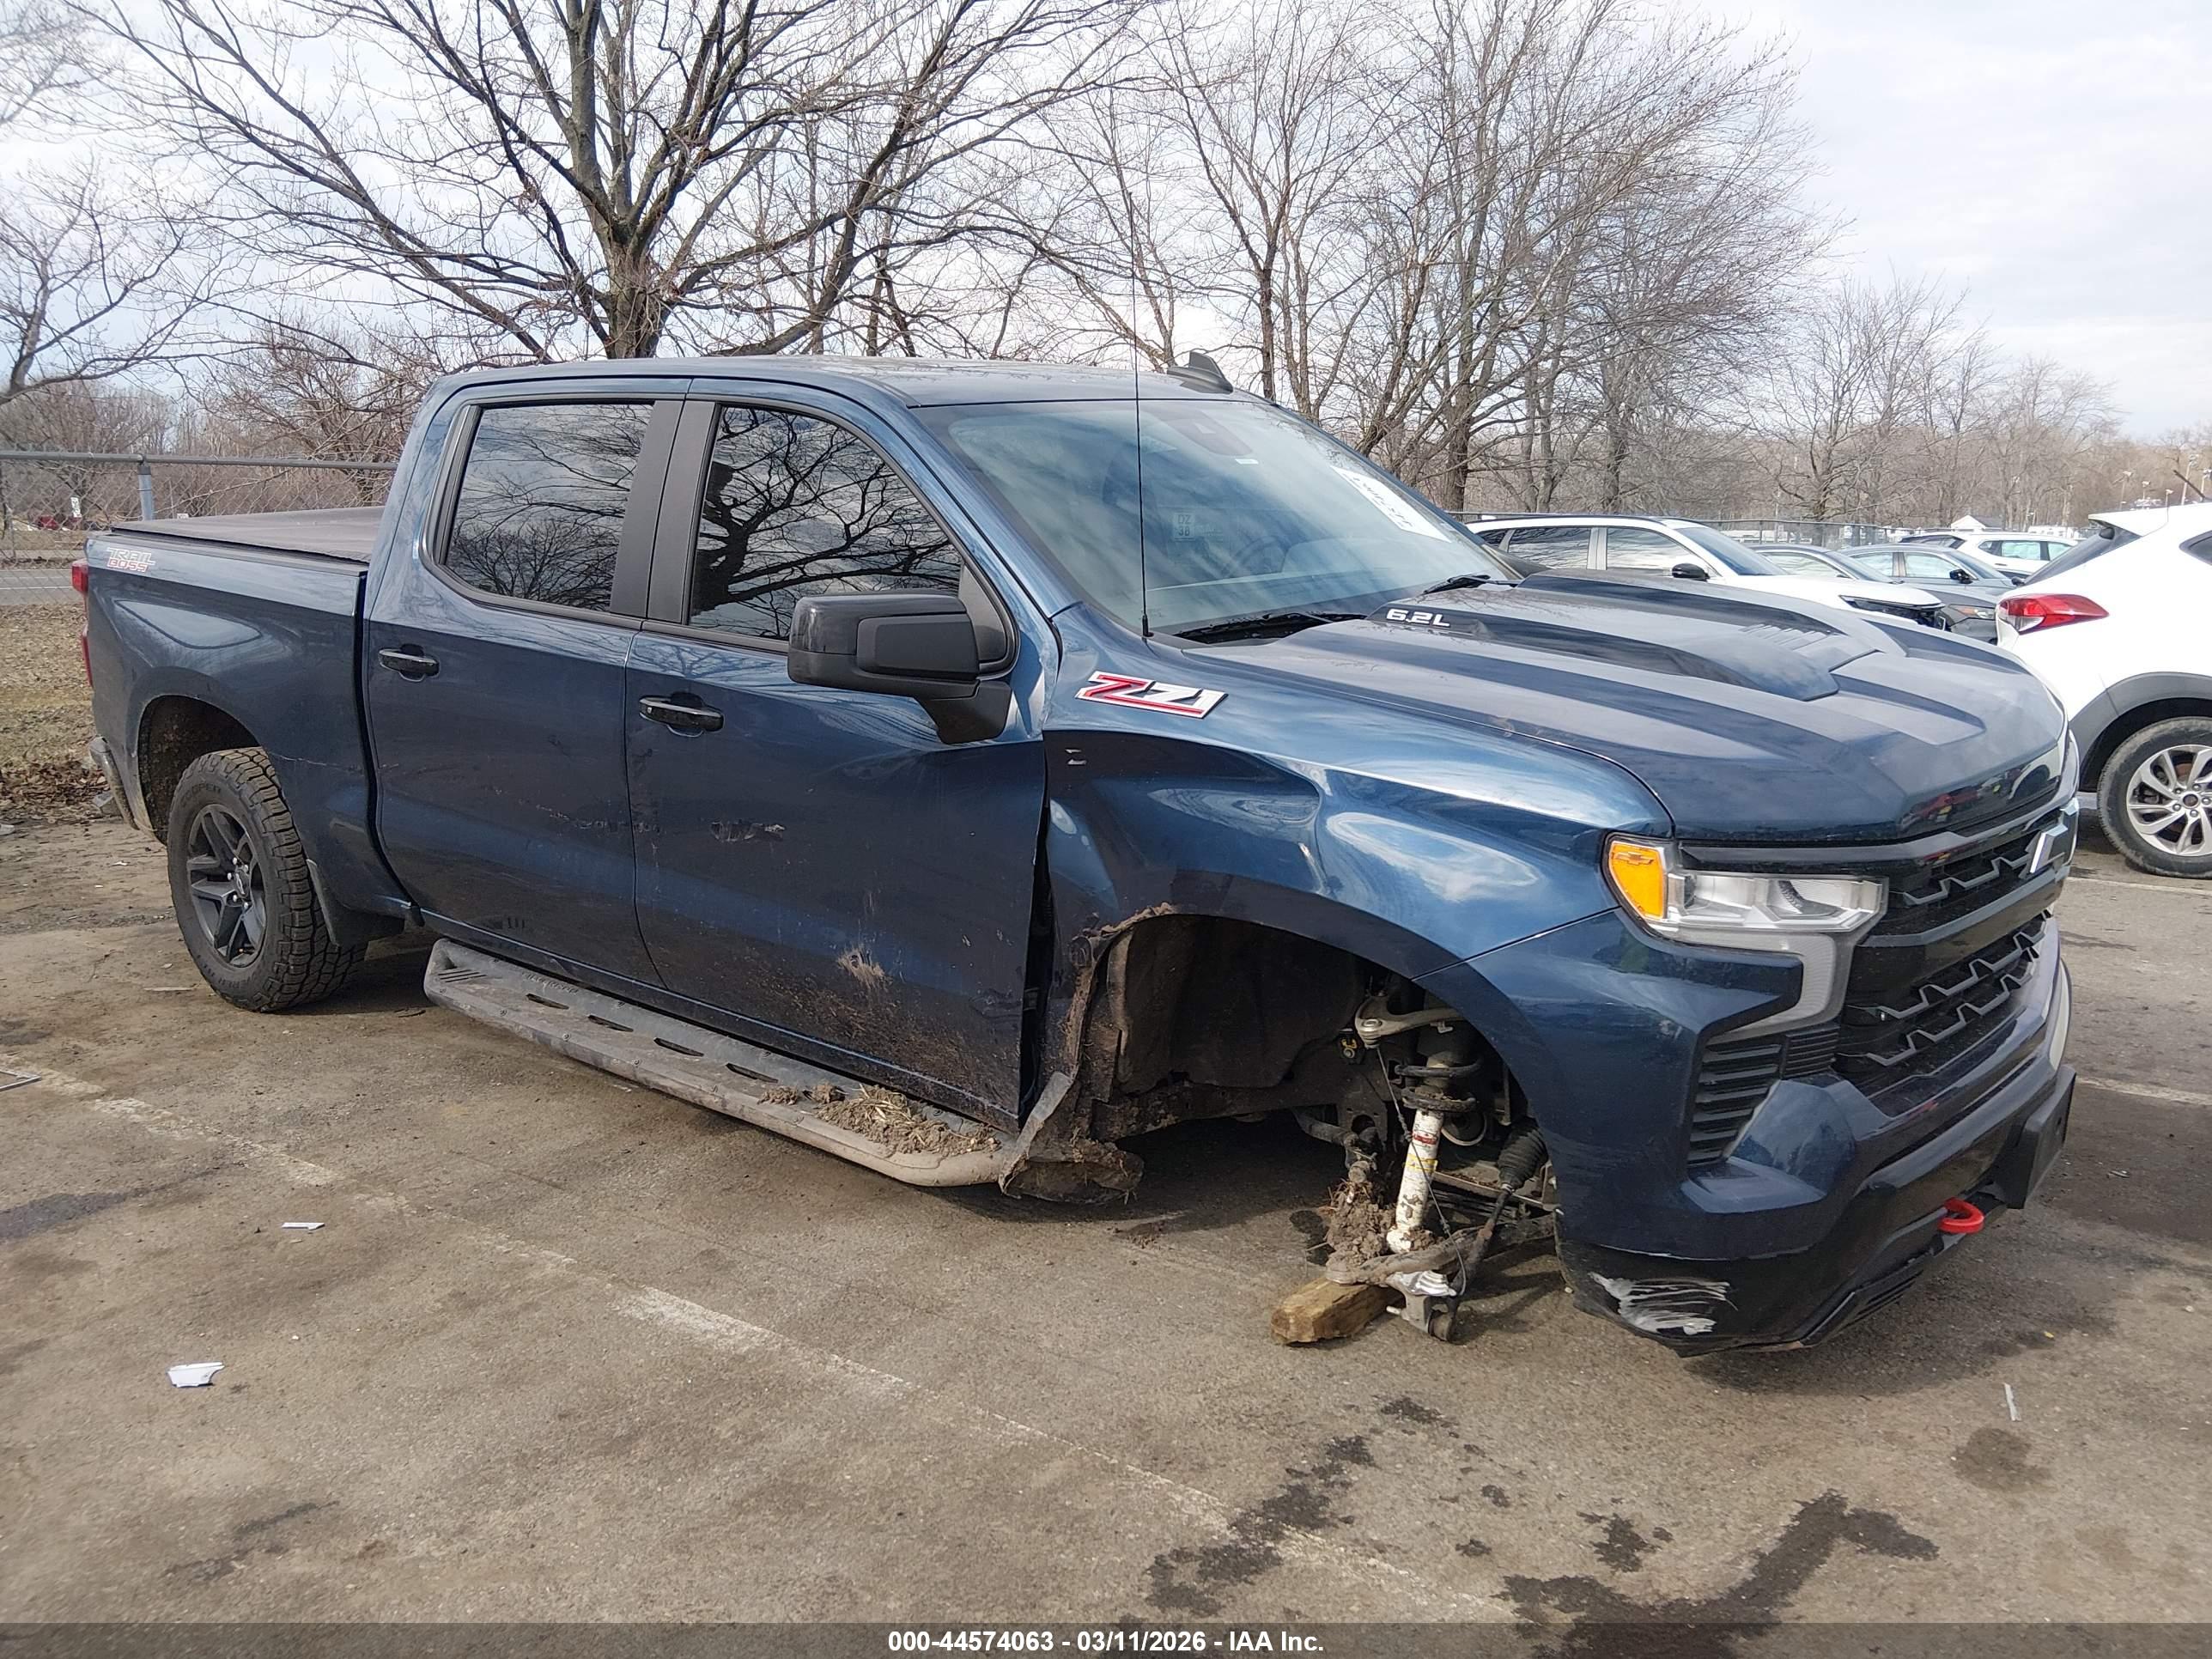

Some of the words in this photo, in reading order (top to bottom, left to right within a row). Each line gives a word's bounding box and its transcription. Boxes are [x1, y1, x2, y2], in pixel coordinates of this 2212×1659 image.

[106, 548, 155, 565] TRAIL
[107, 558, 148, 572] BOSS
[1386, 608, 1451, 629] 6.2L
[1075, 671, 1229, 720] Z71
